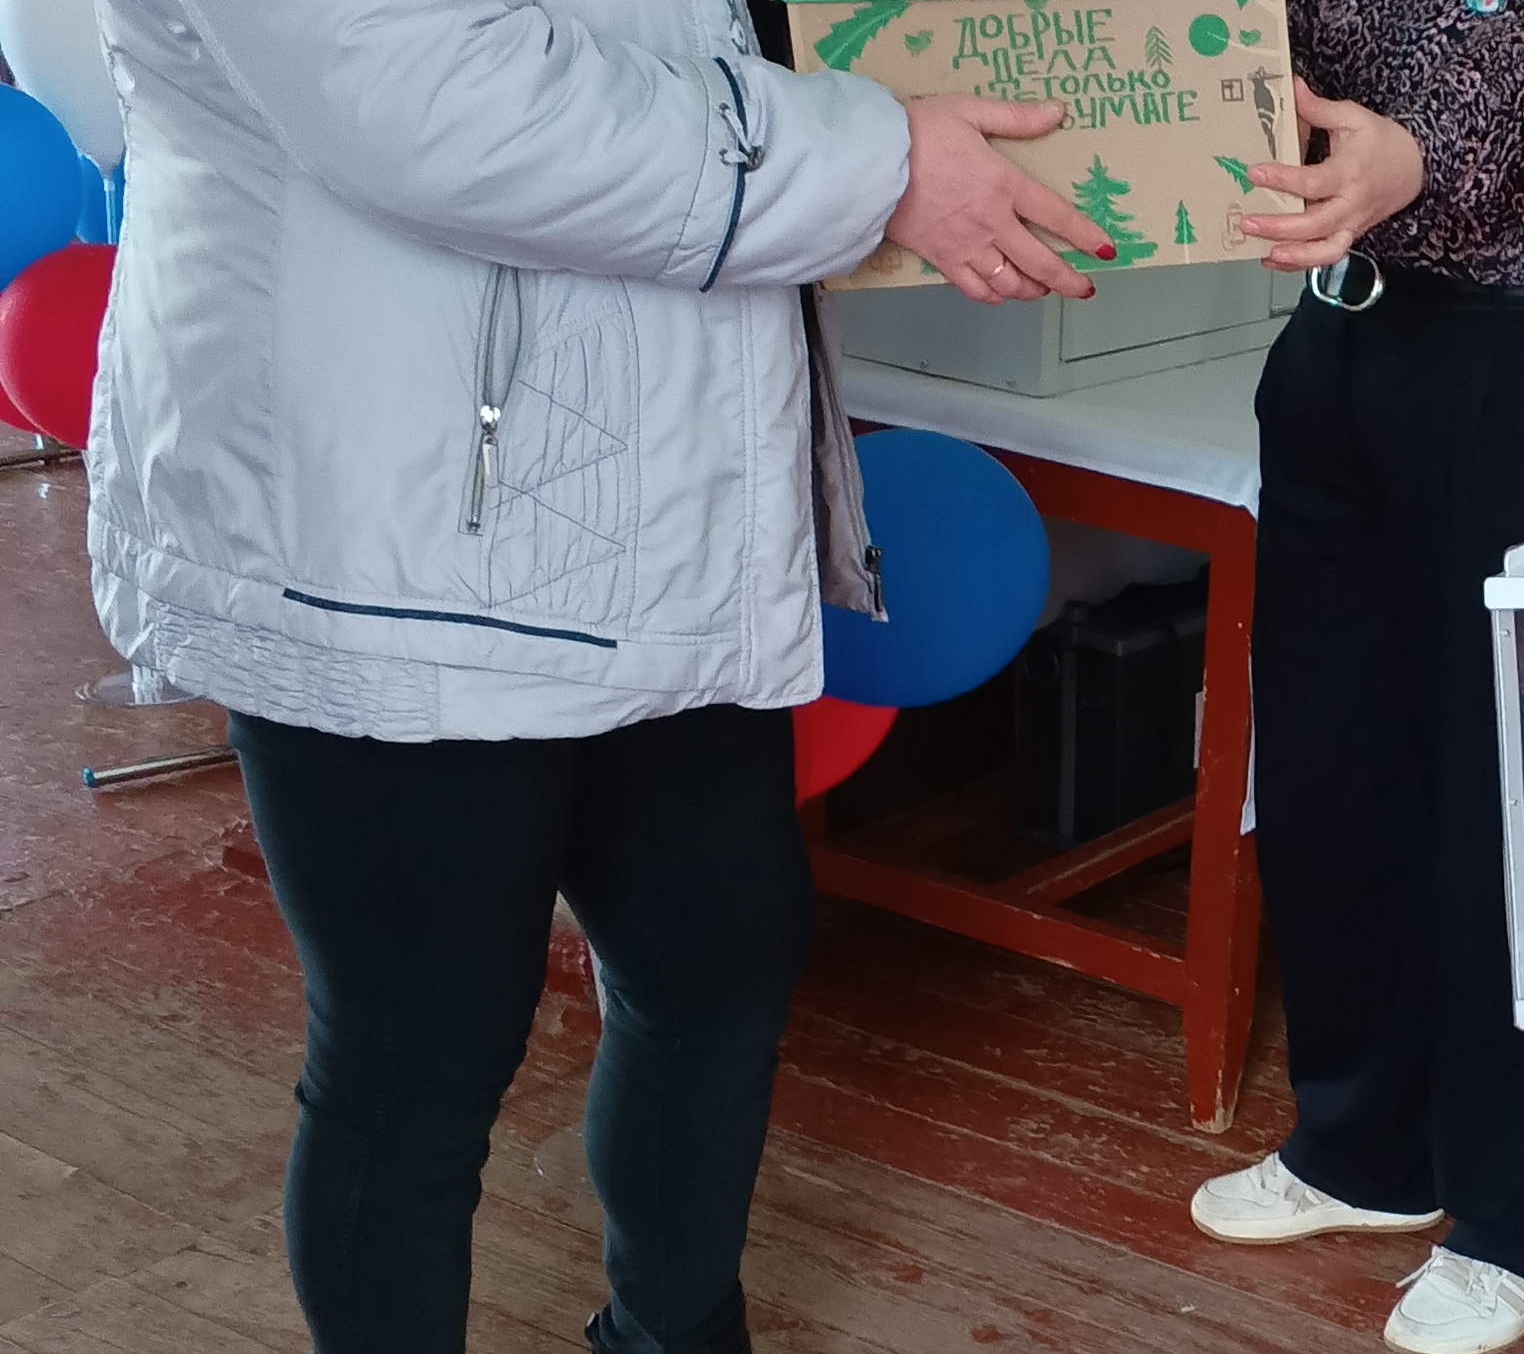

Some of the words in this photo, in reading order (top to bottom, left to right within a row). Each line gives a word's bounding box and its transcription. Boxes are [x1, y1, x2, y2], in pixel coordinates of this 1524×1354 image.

[953, 9, 1117, 70] ДОБРЫЕ
[988, 45, 1117, 92] ДЕЛА
[1031, 68, 1172, 100] ТОЛЬКО
